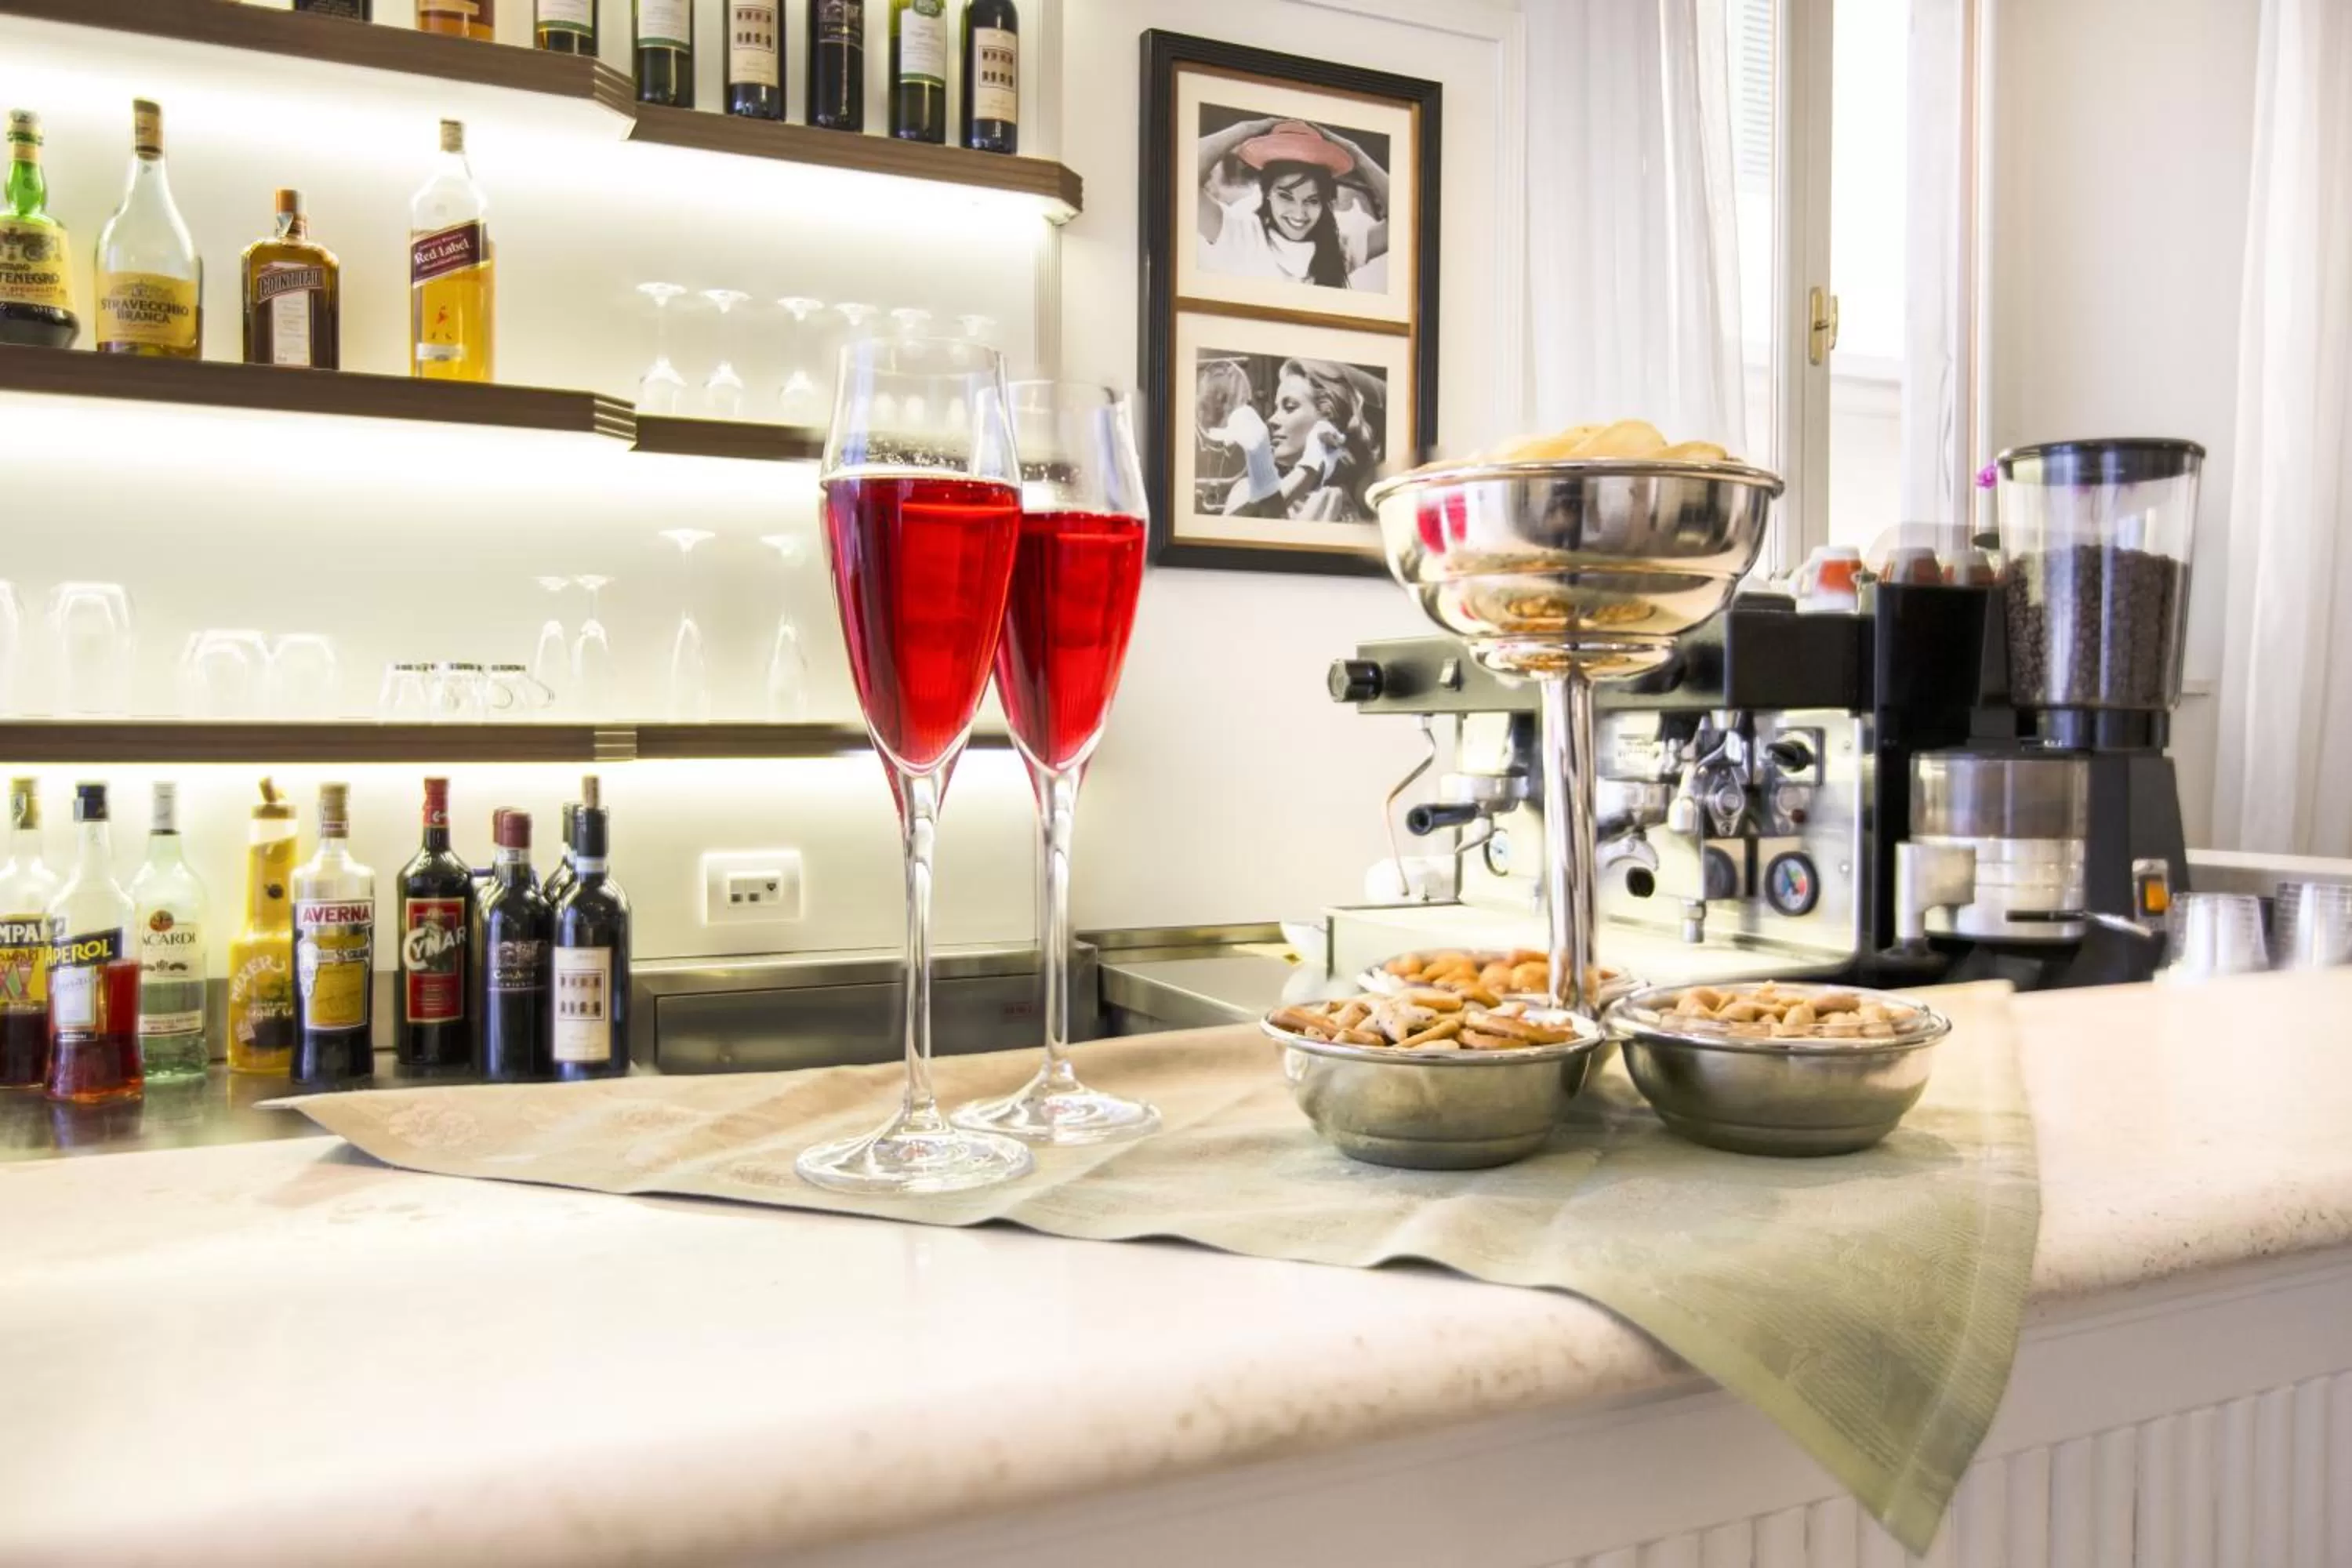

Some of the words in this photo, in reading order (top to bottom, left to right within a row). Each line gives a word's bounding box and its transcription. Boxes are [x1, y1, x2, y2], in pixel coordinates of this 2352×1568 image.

[414, 249, 437, 264] Red
[438, 238, 470, 256] Label
[100, 298, 189, 317] STRAVECCHIO
[116, 307, 172, 325] BRANCA
[303, 904, 371, 923] AVERNA
[45, 938, 114, 967] APEROL
[402, 926, 466, 971] CYNAR
